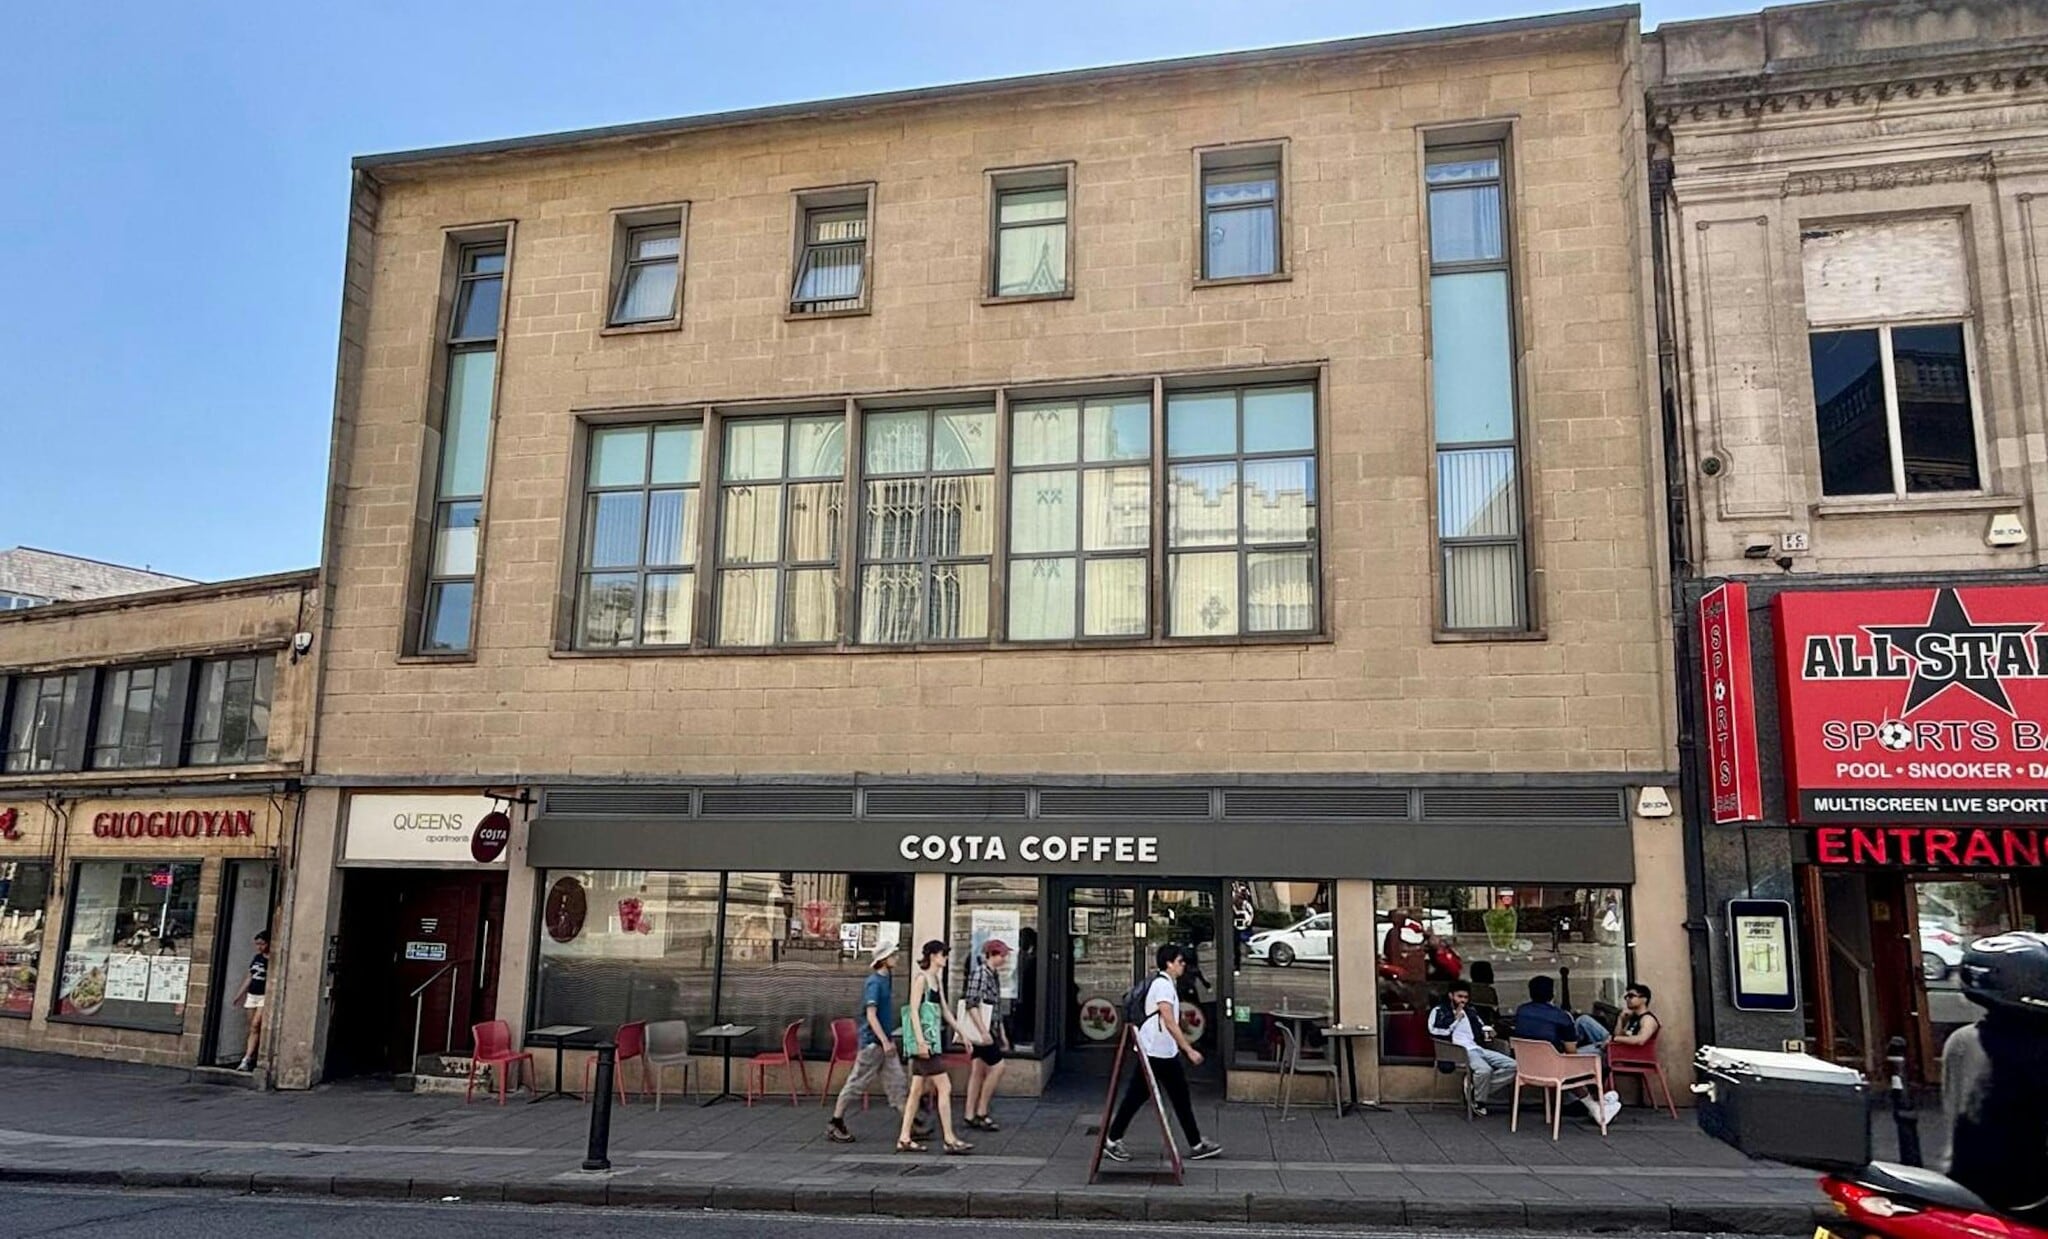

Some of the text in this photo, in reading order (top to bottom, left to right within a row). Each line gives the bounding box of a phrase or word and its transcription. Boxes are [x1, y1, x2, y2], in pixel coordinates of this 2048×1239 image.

[1802, 634, 1910, 680] ALL
[1836, 763, 1893, 778] POOL
[1908, 763, 2012, 778] SNOOKER
[1814, 798, 1937, 812] MULTISCREEN
[1943, 798, 1983, 812] LIVE
[93, 810, 253, 838] GUOGUOYAN
[393, 813, 463, 831] QUEENS
[480, 828, 507, 841] COSTA
[899, 835, 1158, 864] COSTA COFFEE
[1817, 828, 2048, 866] ENTRAN
